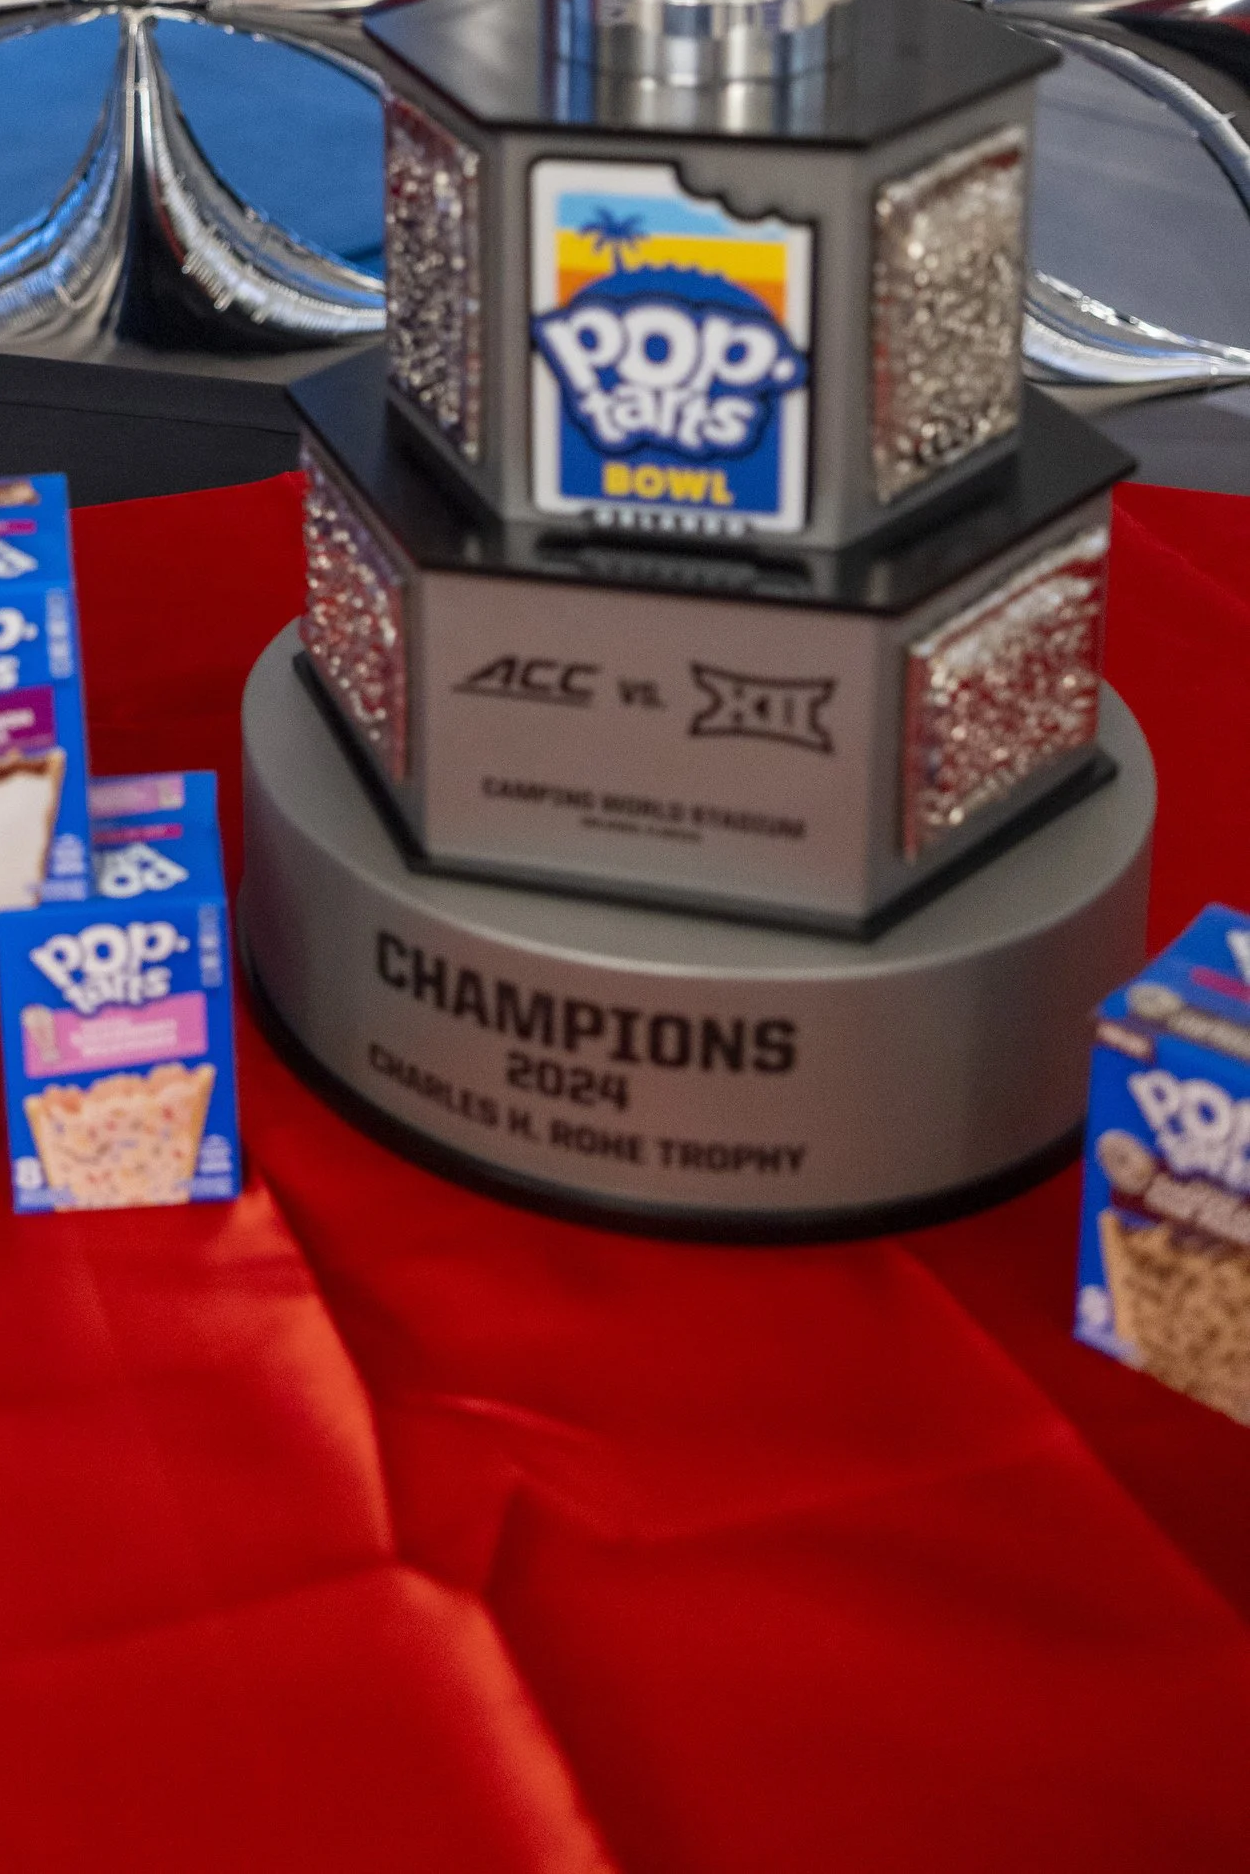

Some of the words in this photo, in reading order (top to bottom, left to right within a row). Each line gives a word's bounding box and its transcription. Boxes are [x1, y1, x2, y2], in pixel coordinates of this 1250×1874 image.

[602, 462, 736, 507] BOWL
[452, 654, 602, 706] ACC
[375, 929, 798, 1074] CHAMPIONS
[367, 1041, 500, 1128] CHARLES
[652, 1135, 807, 1175] TROPHY
[505, 1049, 630, 1113] 2024
